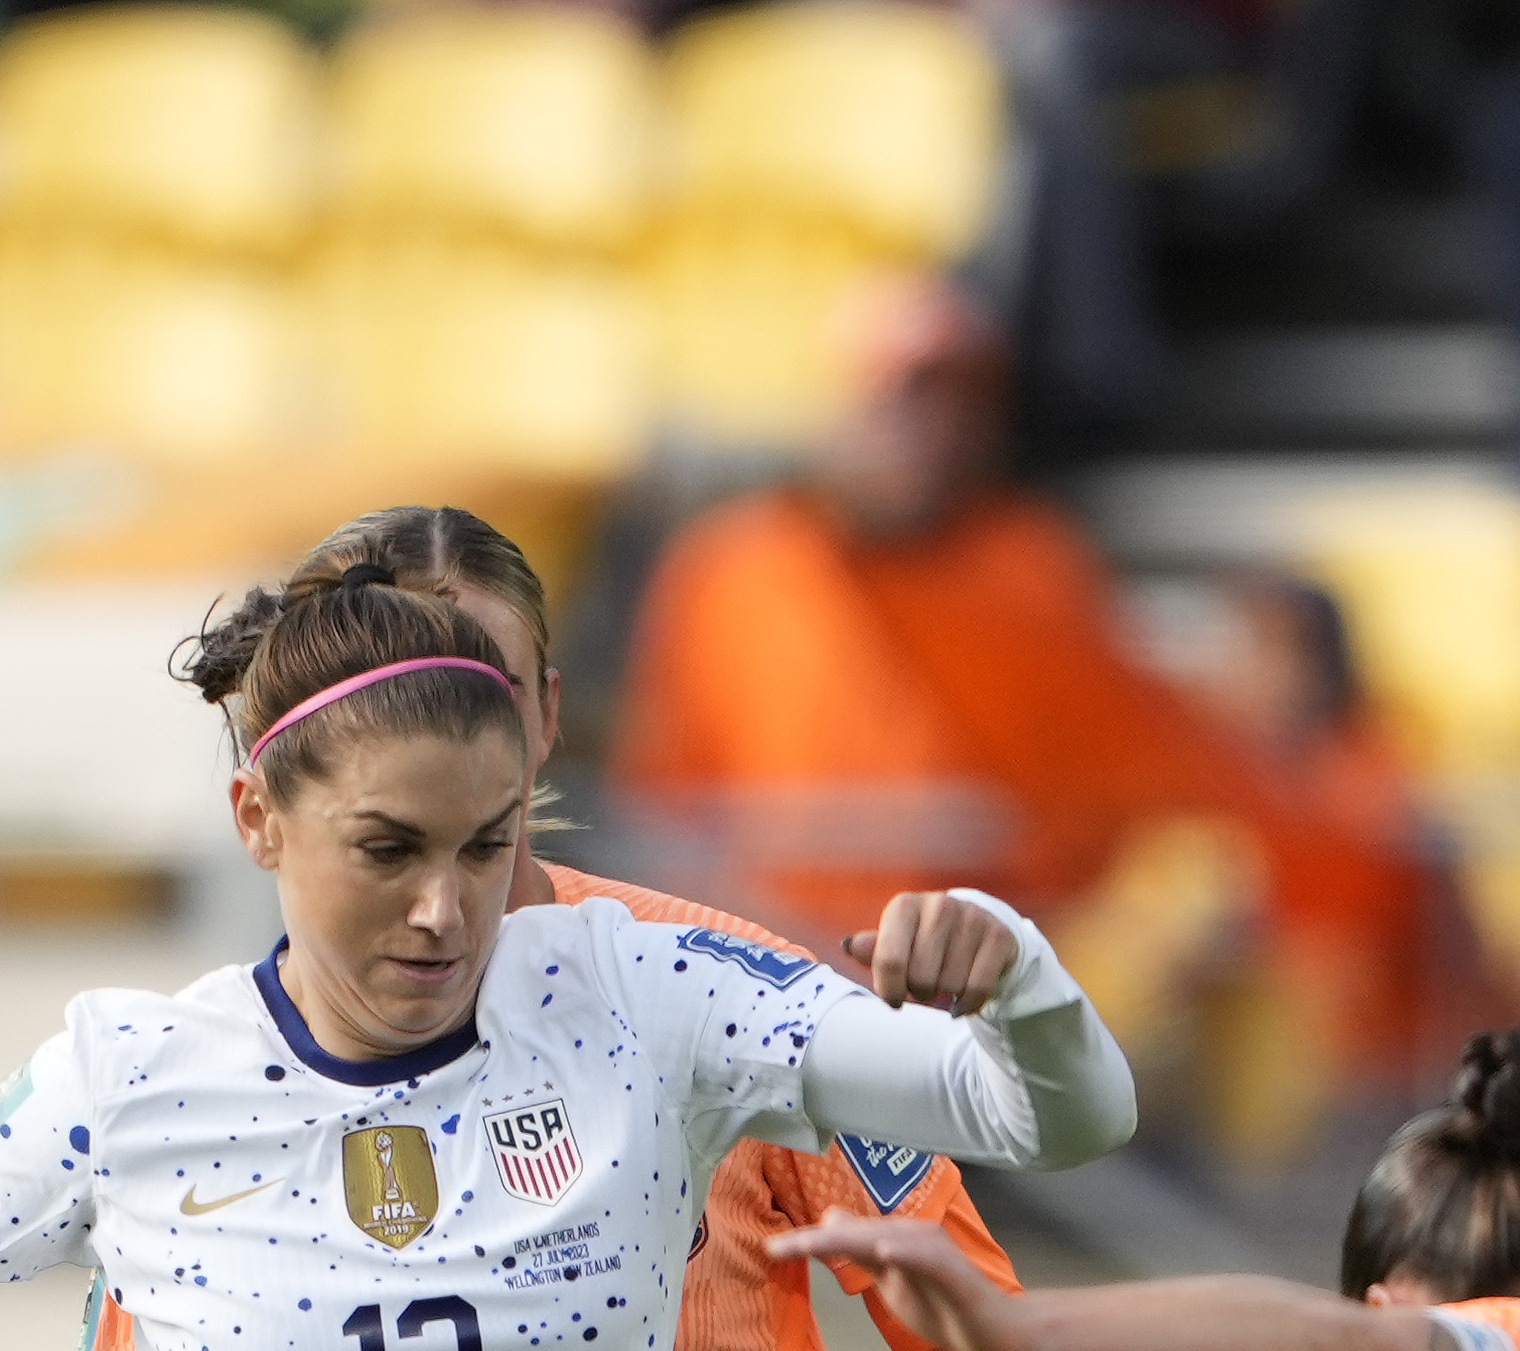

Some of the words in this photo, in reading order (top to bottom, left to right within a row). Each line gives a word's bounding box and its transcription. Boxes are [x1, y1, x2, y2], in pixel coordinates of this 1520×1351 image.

[492, 1106, 563, 1152] USA
[371, 1201, 417, 1221] FIFA
[384, 1223, 410, 1237] 2019
[514, 1240, 532, 1255] USA
[540, 1221, 601, 1248] NETHERLANDS
[532, 1251, 543, 1268] 27
[546, 1248, 566, 1266] JULY
[504, 1269, 562, 1291] WELLINGTON
[585, 1254, 622, 1275] ZEALAND
